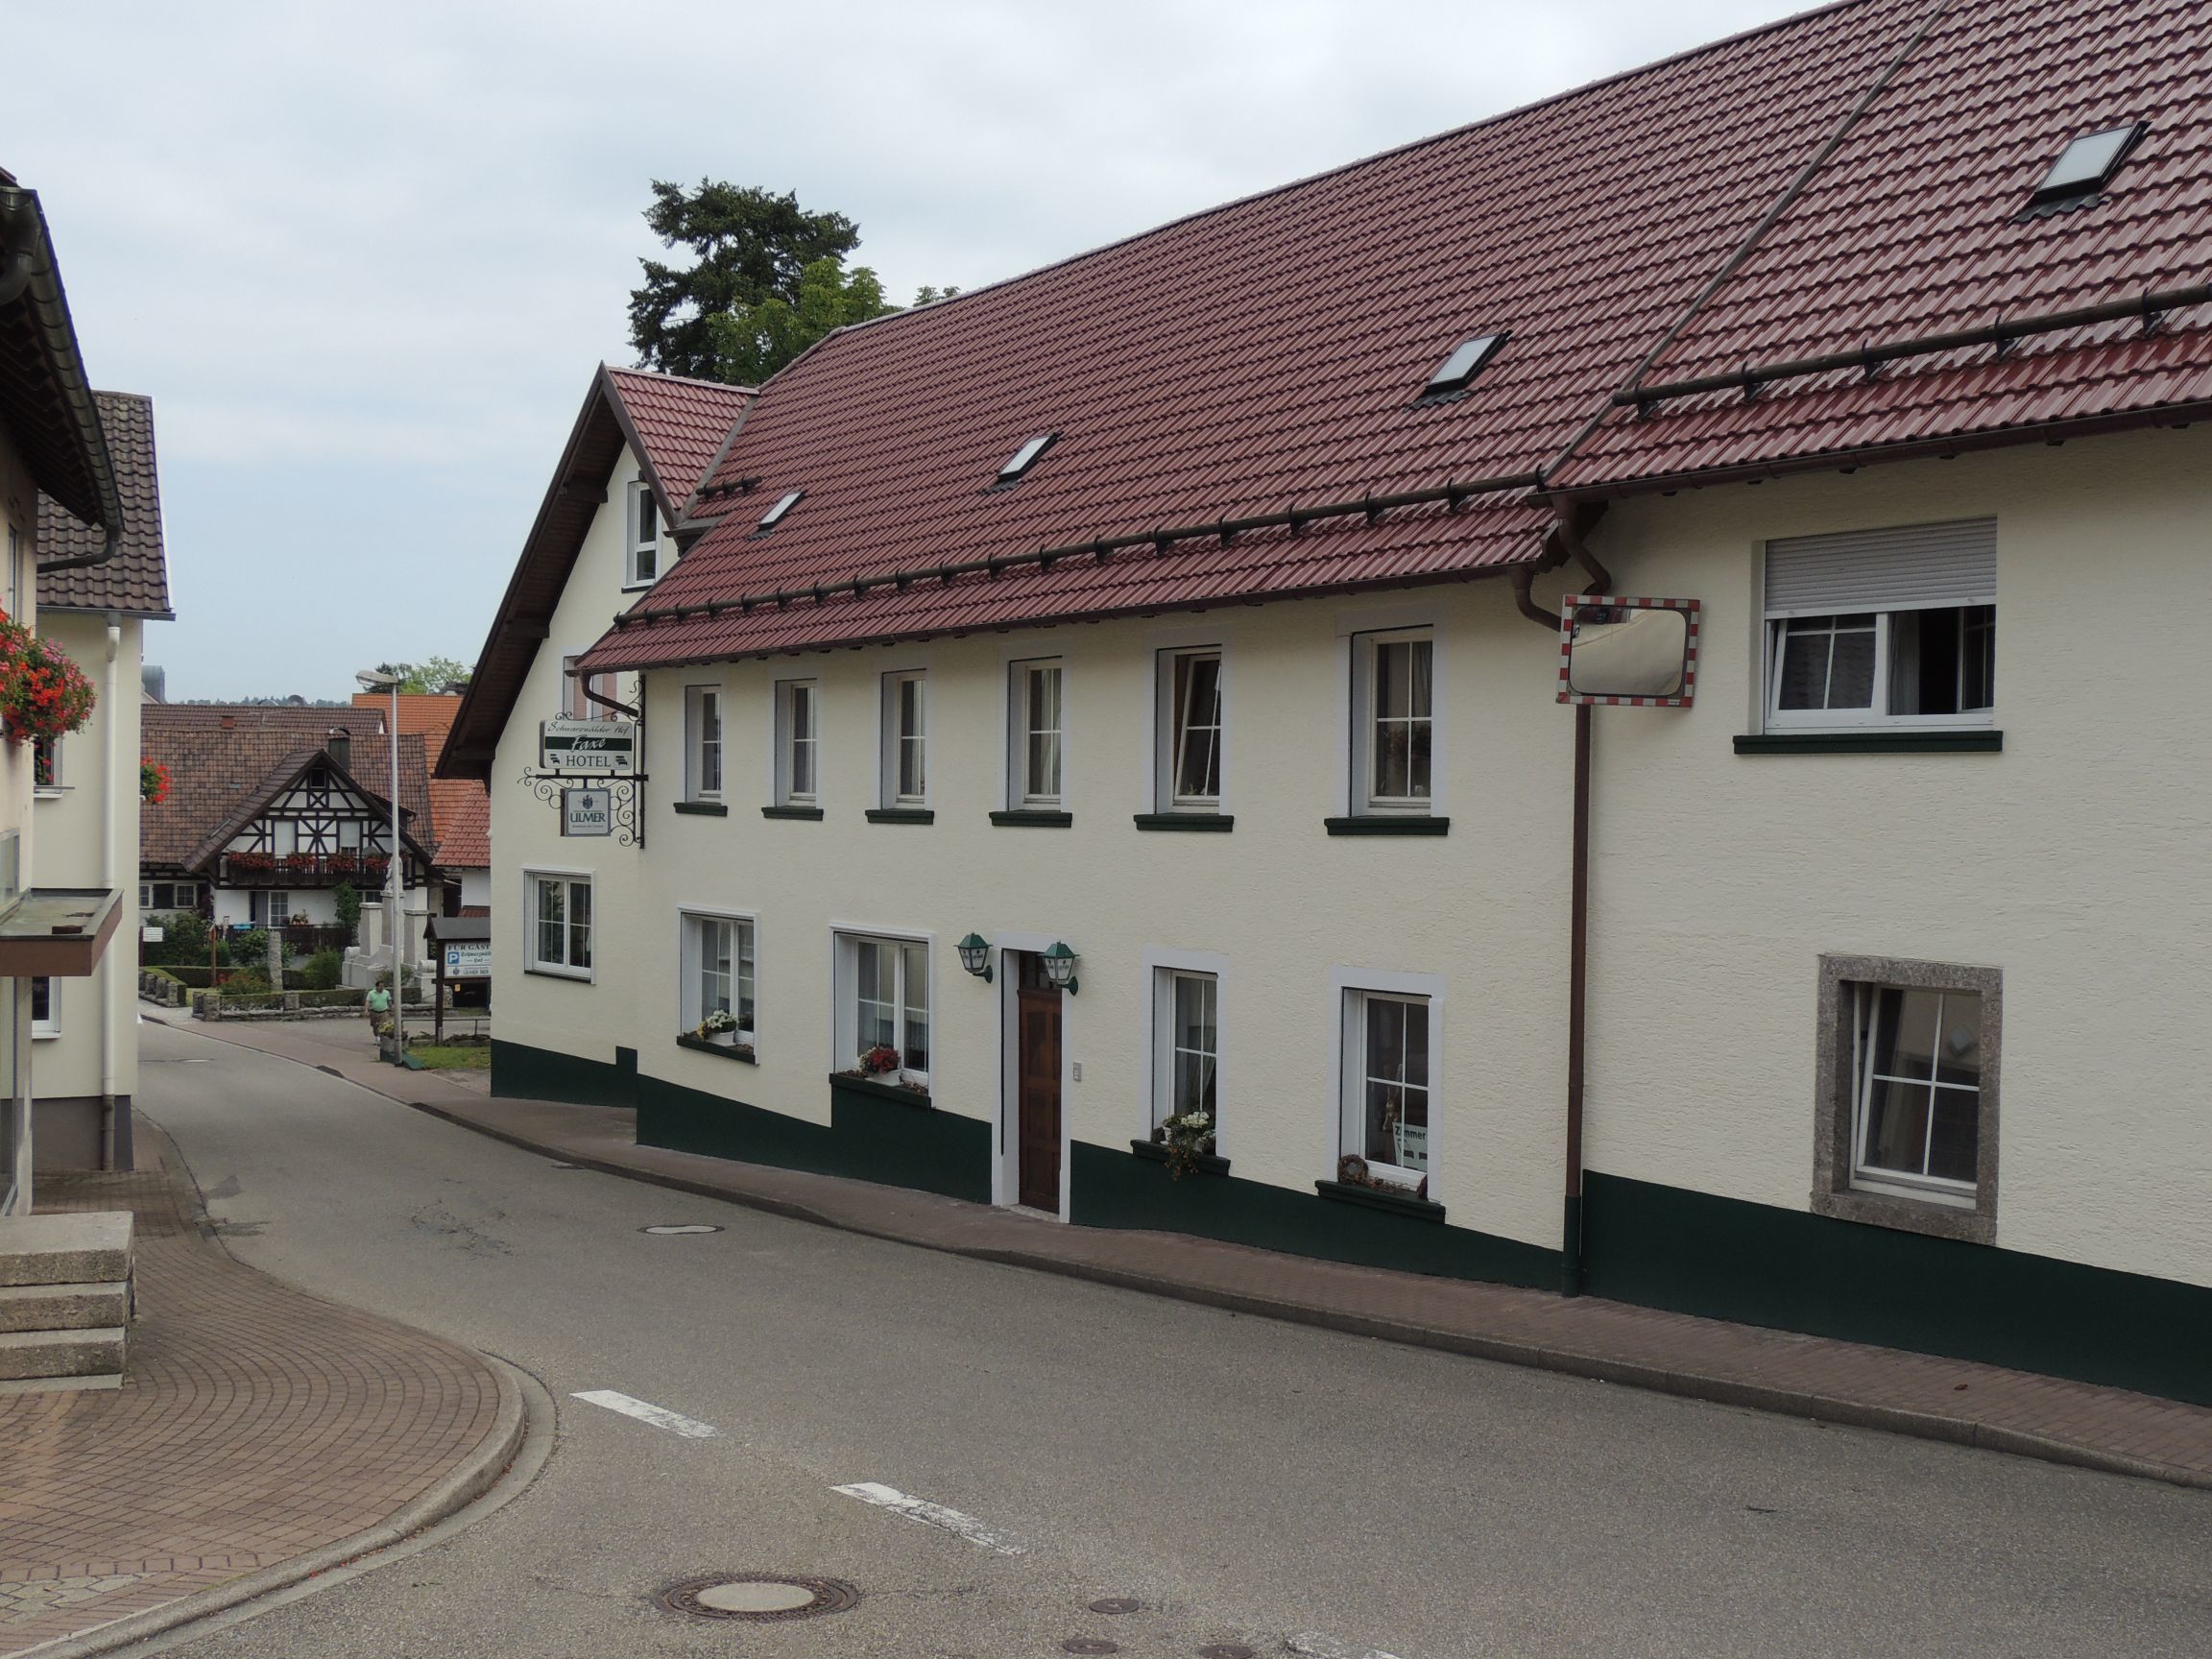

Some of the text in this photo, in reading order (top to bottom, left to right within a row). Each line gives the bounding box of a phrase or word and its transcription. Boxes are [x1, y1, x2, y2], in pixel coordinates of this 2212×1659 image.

[565, 755, 612, 767] HOTEL
[569, 812, 606, 823] ULMER
[448, 952, 458, 963] P
[1395, 1125, 1427, 1141] Zmmer
